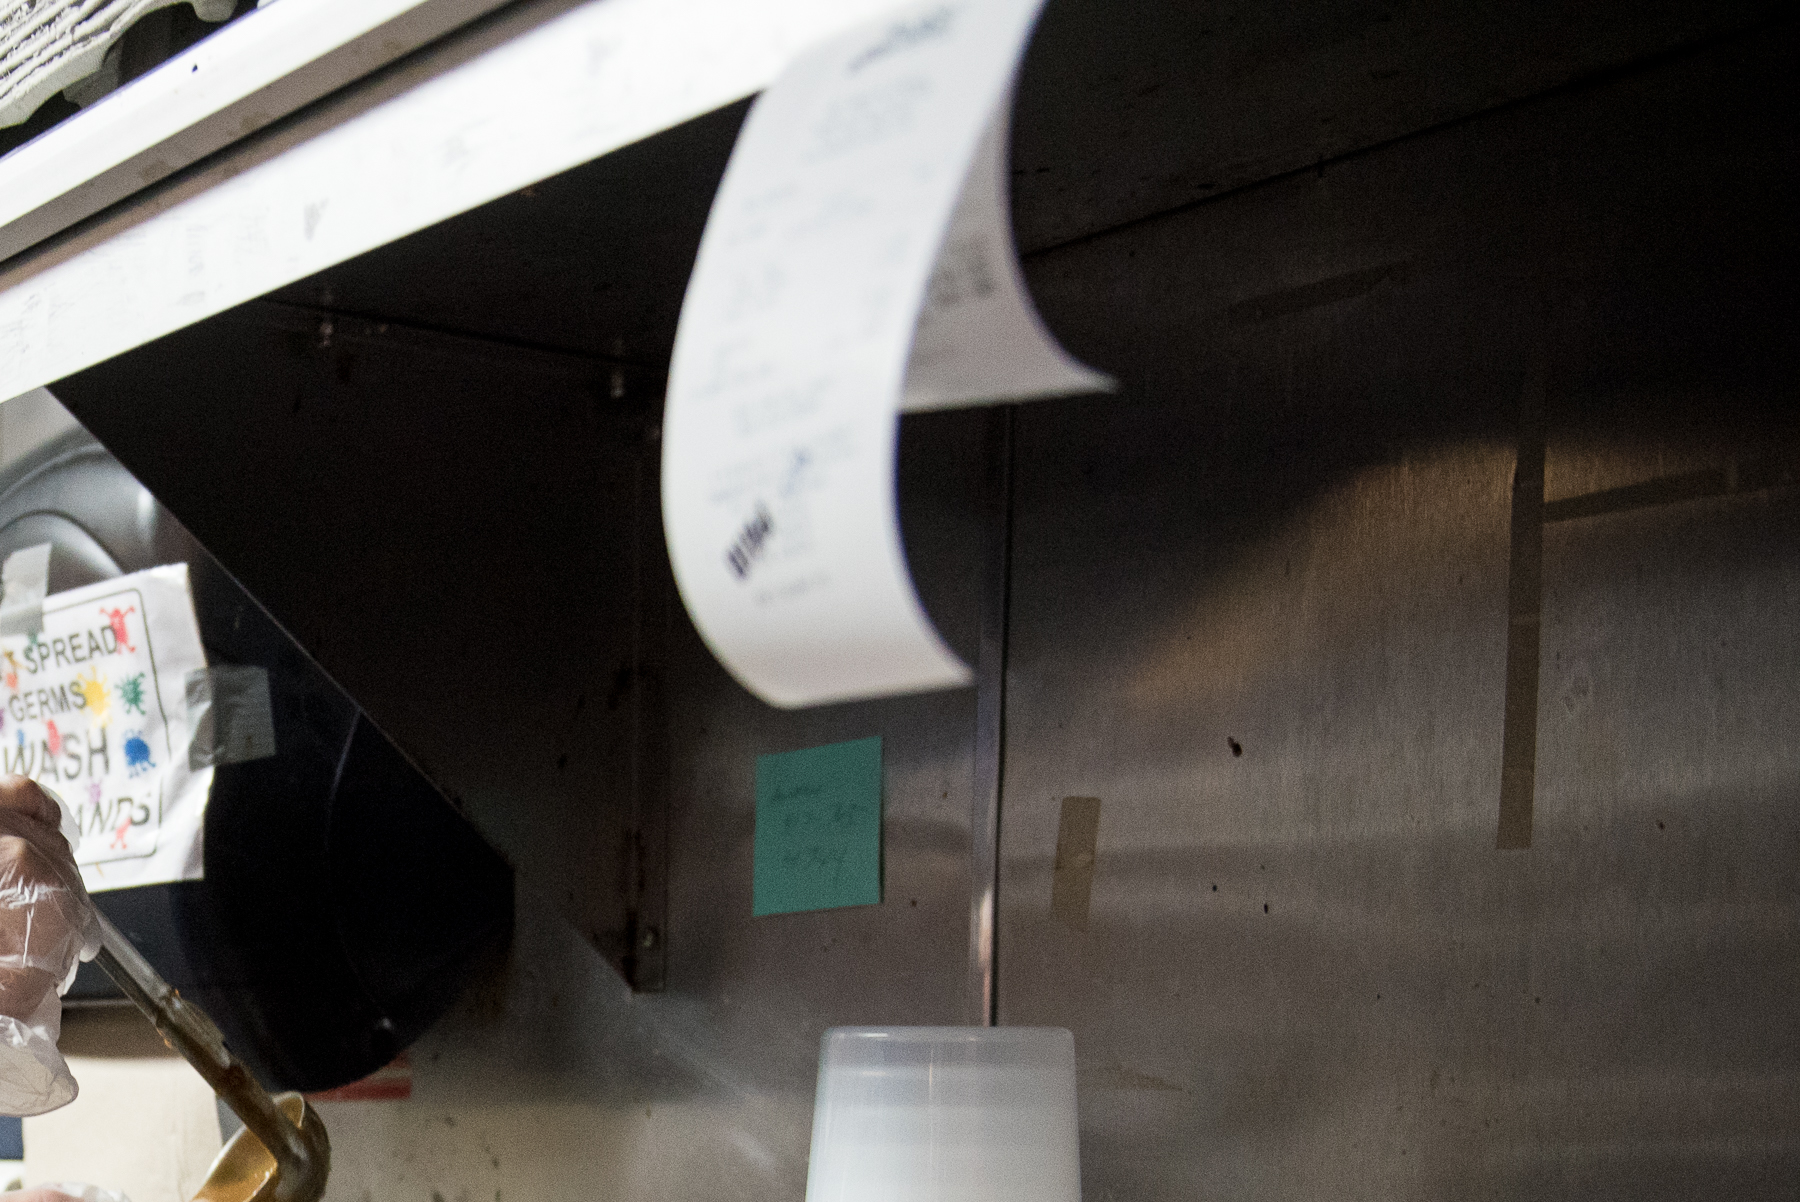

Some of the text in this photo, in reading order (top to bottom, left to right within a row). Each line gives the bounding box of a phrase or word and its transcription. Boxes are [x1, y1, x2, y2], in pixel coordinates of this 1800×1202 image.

[23, 624, 119, 674] SPREAD
[8, 681, 88, 723] GERMS
[3, 727, 110, 782] WASH
